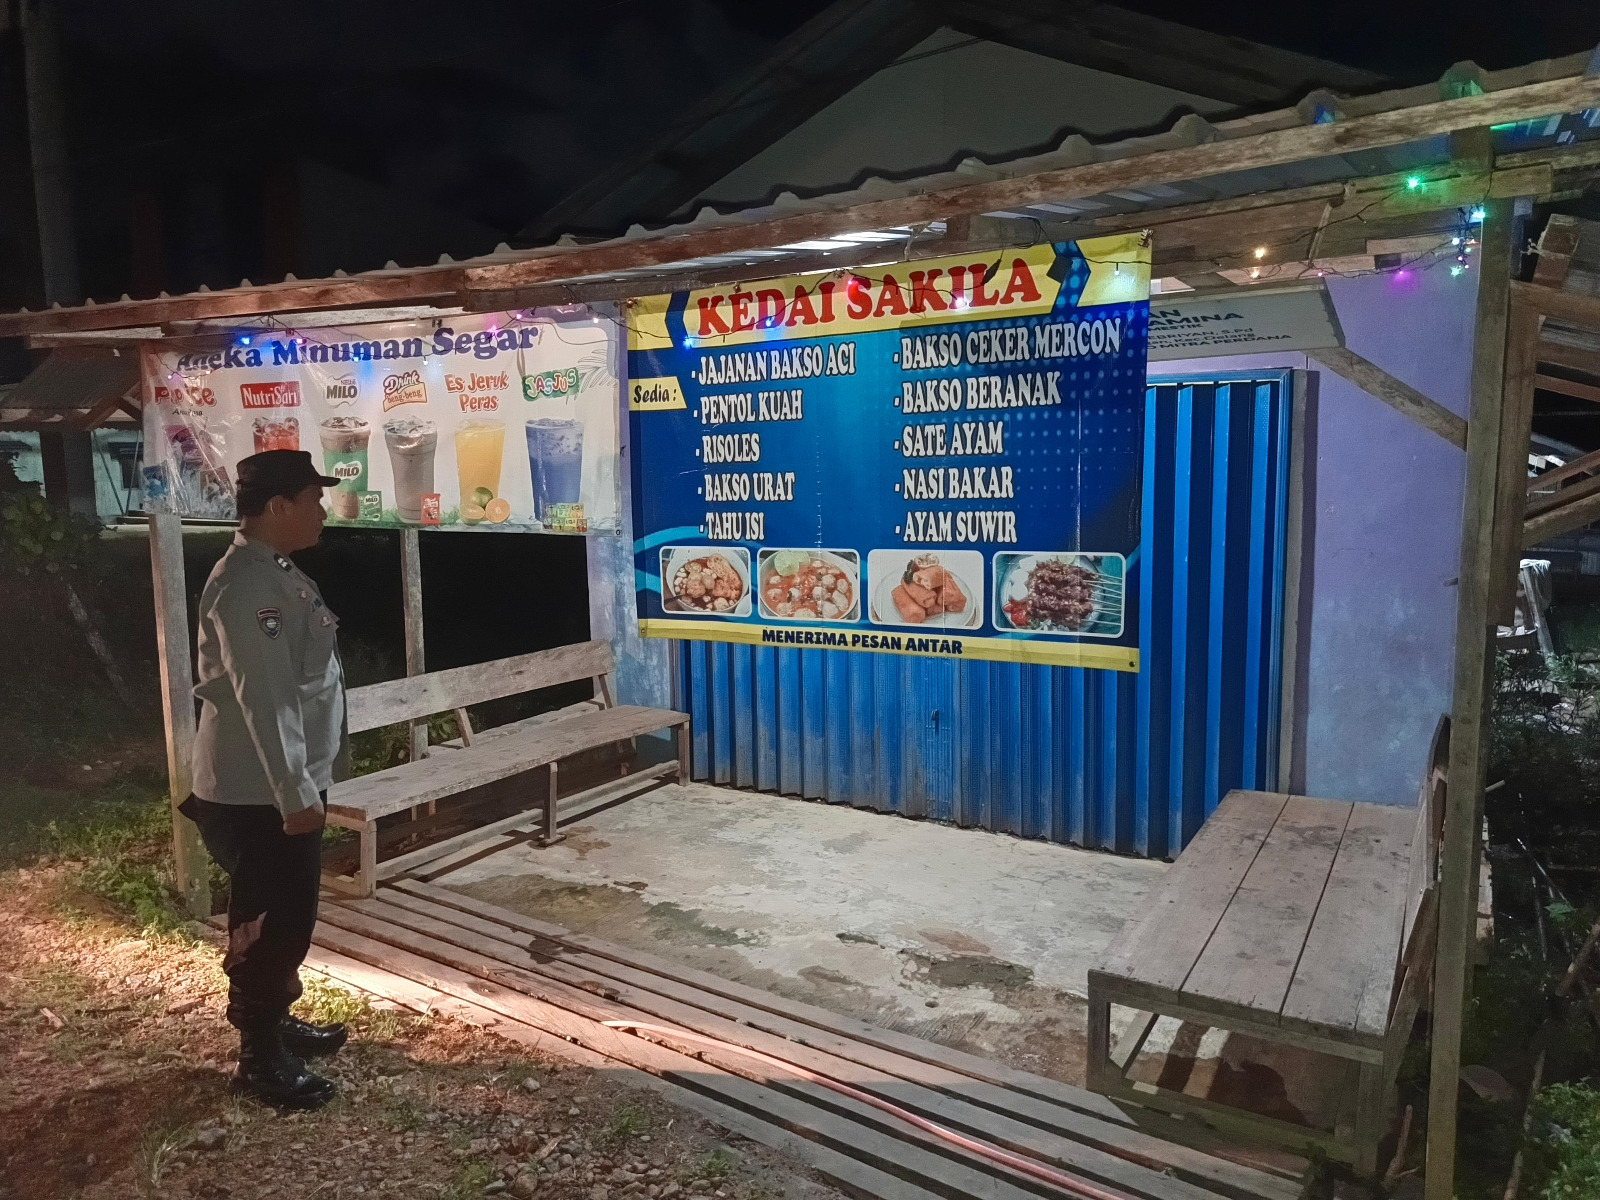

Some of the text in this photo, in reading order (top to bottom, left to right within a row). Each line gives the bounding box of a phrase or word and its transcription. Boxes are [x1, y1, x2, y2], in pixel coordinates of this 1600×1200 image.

[697, 258, 1042, 336] KEDAI SAKILA
[272, 338, 426, 366] Minuman
[431, 326, 540, 360] Segar
[901, 318, 1121, 370] BAKSO CEKER MERCON
[698, 342, 857, 385] JAJANAN BAKSO ACI
[326, 384, 358, 399] MILO
[383, 370, 420, 394] Drink
[444, 371, 509, 393] Es Jeruk
[633, 383, 670, 403] Sedia
[902, 371, 1062, 413] BAKSO BERANAK
[459, 394, 499, 412] Peras
[700, 389, 803, 425] PENTOL KUAH
[702, 433, 760, 463] RISOLES
[902, 421, 1004, 457] SATE AYAM
[335, 466, 360, 477] MILO
[903, 466, 1014, 499] NASI BAKAR
[704, 472, 796, 502] BAKSO URAT
[706, 512, 765, 540] TAHU ISI
[903, 511, 1018, 543] AYAM SUWIR
[762, 629, 963, 655] MENERIMA PESAN ANTAR
